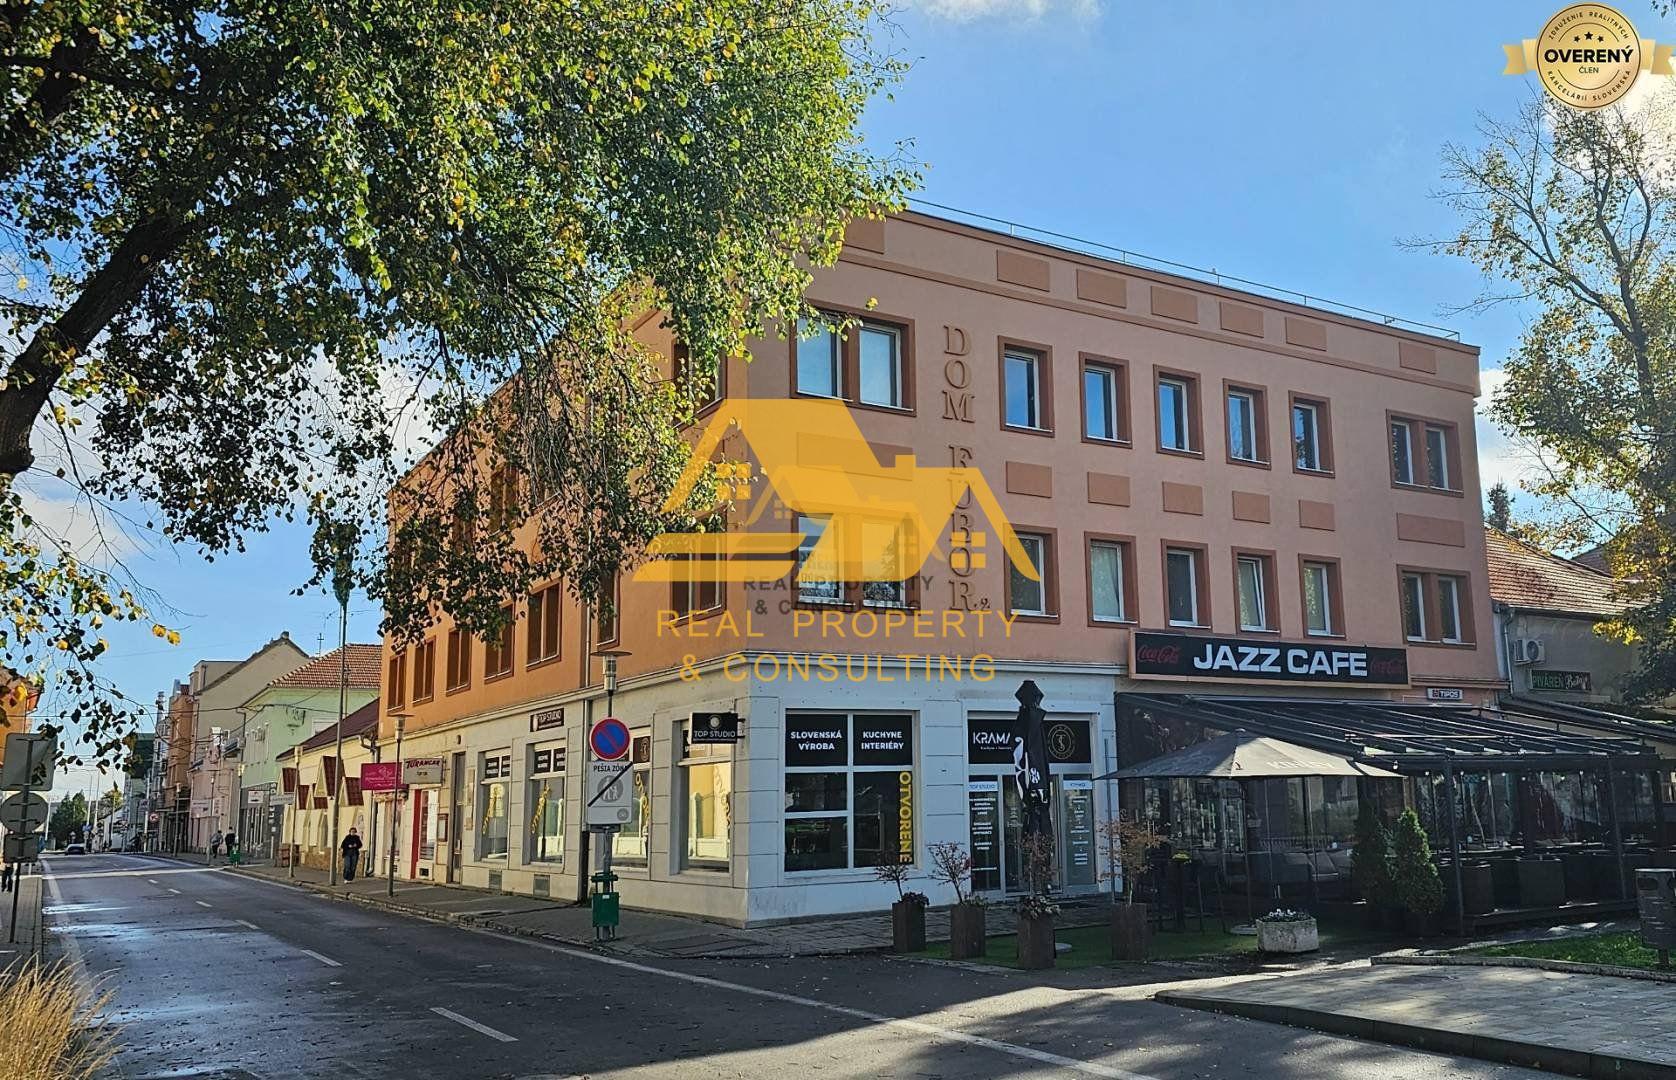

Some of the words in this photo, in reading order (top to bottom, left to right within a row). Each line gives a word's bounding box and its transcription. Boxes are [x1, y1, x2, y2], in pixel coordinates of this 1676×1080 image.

[942, 325, 975, 424] DOM
[1193, 643, 1282, 673] JAZZ
[1287, 648, 1368, 677] CAFE
[1439, 690, 1459, 698] TIPOS
[694, 730, 709, 738] TOP
[710, 730, 736, 738] STUDIO
[790, 730, 842, 739] SLOVENSKÁ
[863, 731, 902, 739] KUCHYNE
[798, 741, 835, 750] VÝROBA
[861, 741, 904, 750] INTERIÉRY
[593, 763, 611, 772] PEŠIA
[899, 771, 913, 864] OTVORENÉ
